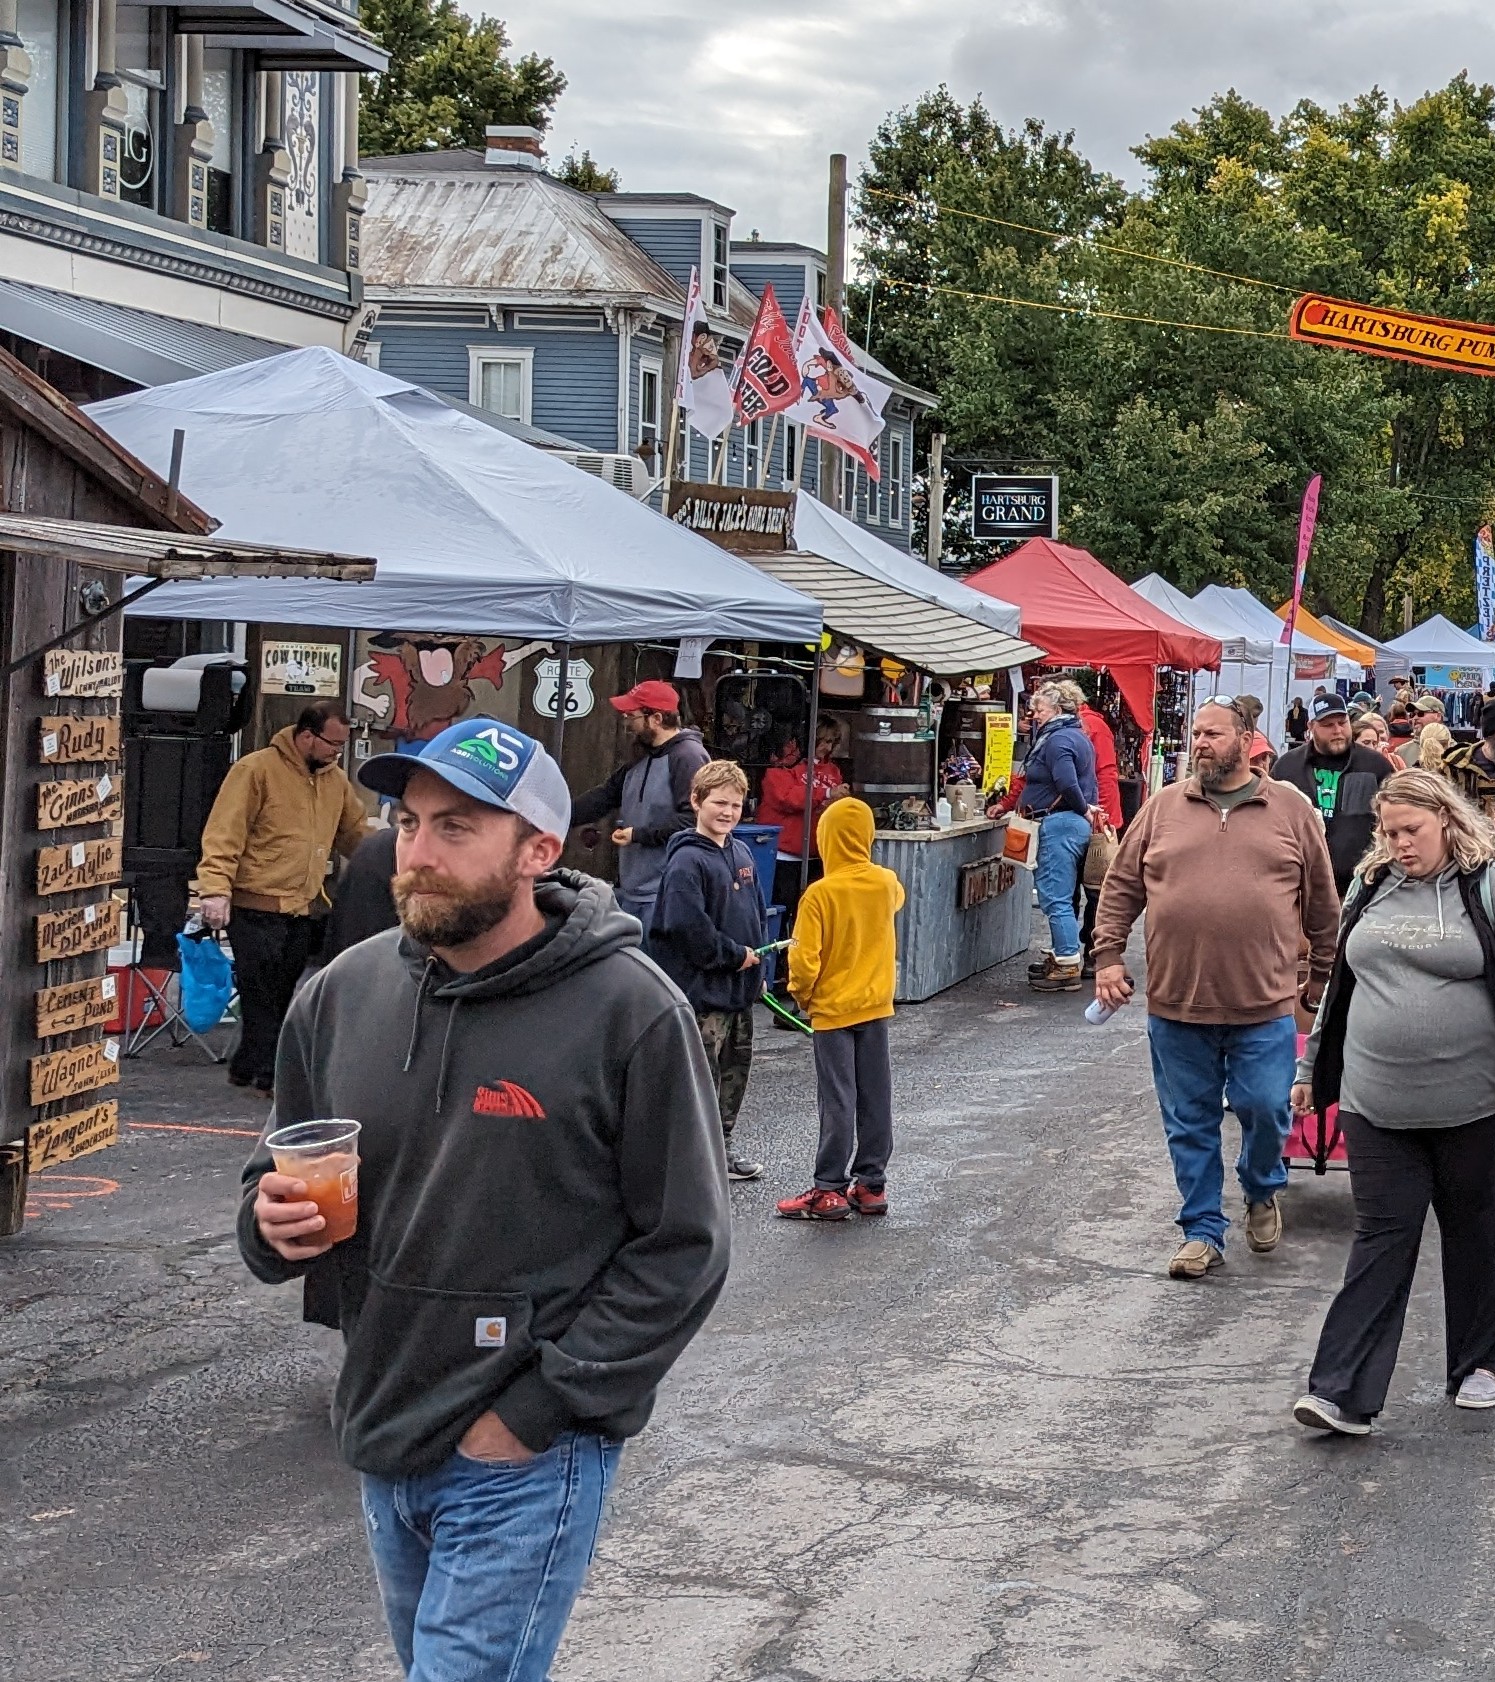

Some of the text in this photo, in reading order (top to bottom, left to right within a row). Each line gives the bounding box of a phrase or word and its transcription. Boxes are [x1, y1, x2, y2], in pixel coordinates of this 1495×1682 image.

[1321, 308, 1454, 352] HARTSBURG
[748, 345, 791, 398] COLD
[981, 494, 1046, 506] HARTSBURG
[692, 499, 720, 531] BILLY
[719, 495, 748, 532] JACK'S
[982, 506, 1045, 521] GRAND
[49, 652, 67, 674] The
[61, 653, 117, 689] Wilson's
[266, 650, 338, 673] COW TIPPING
[547, 666, 582, 677] ROTE
[554, 681, 574, 690] US
[548, 692, 579, 713] 66
[56, 721, 105, 760] Rudy
[49, 784, 94, 822] Ginns
[84, 1000, 114, 1025] POND
[35, 1056, 52, 1078] The
[42, 1050, 108, 1096] Wagner
[33, 1124, 52, 1148] The
